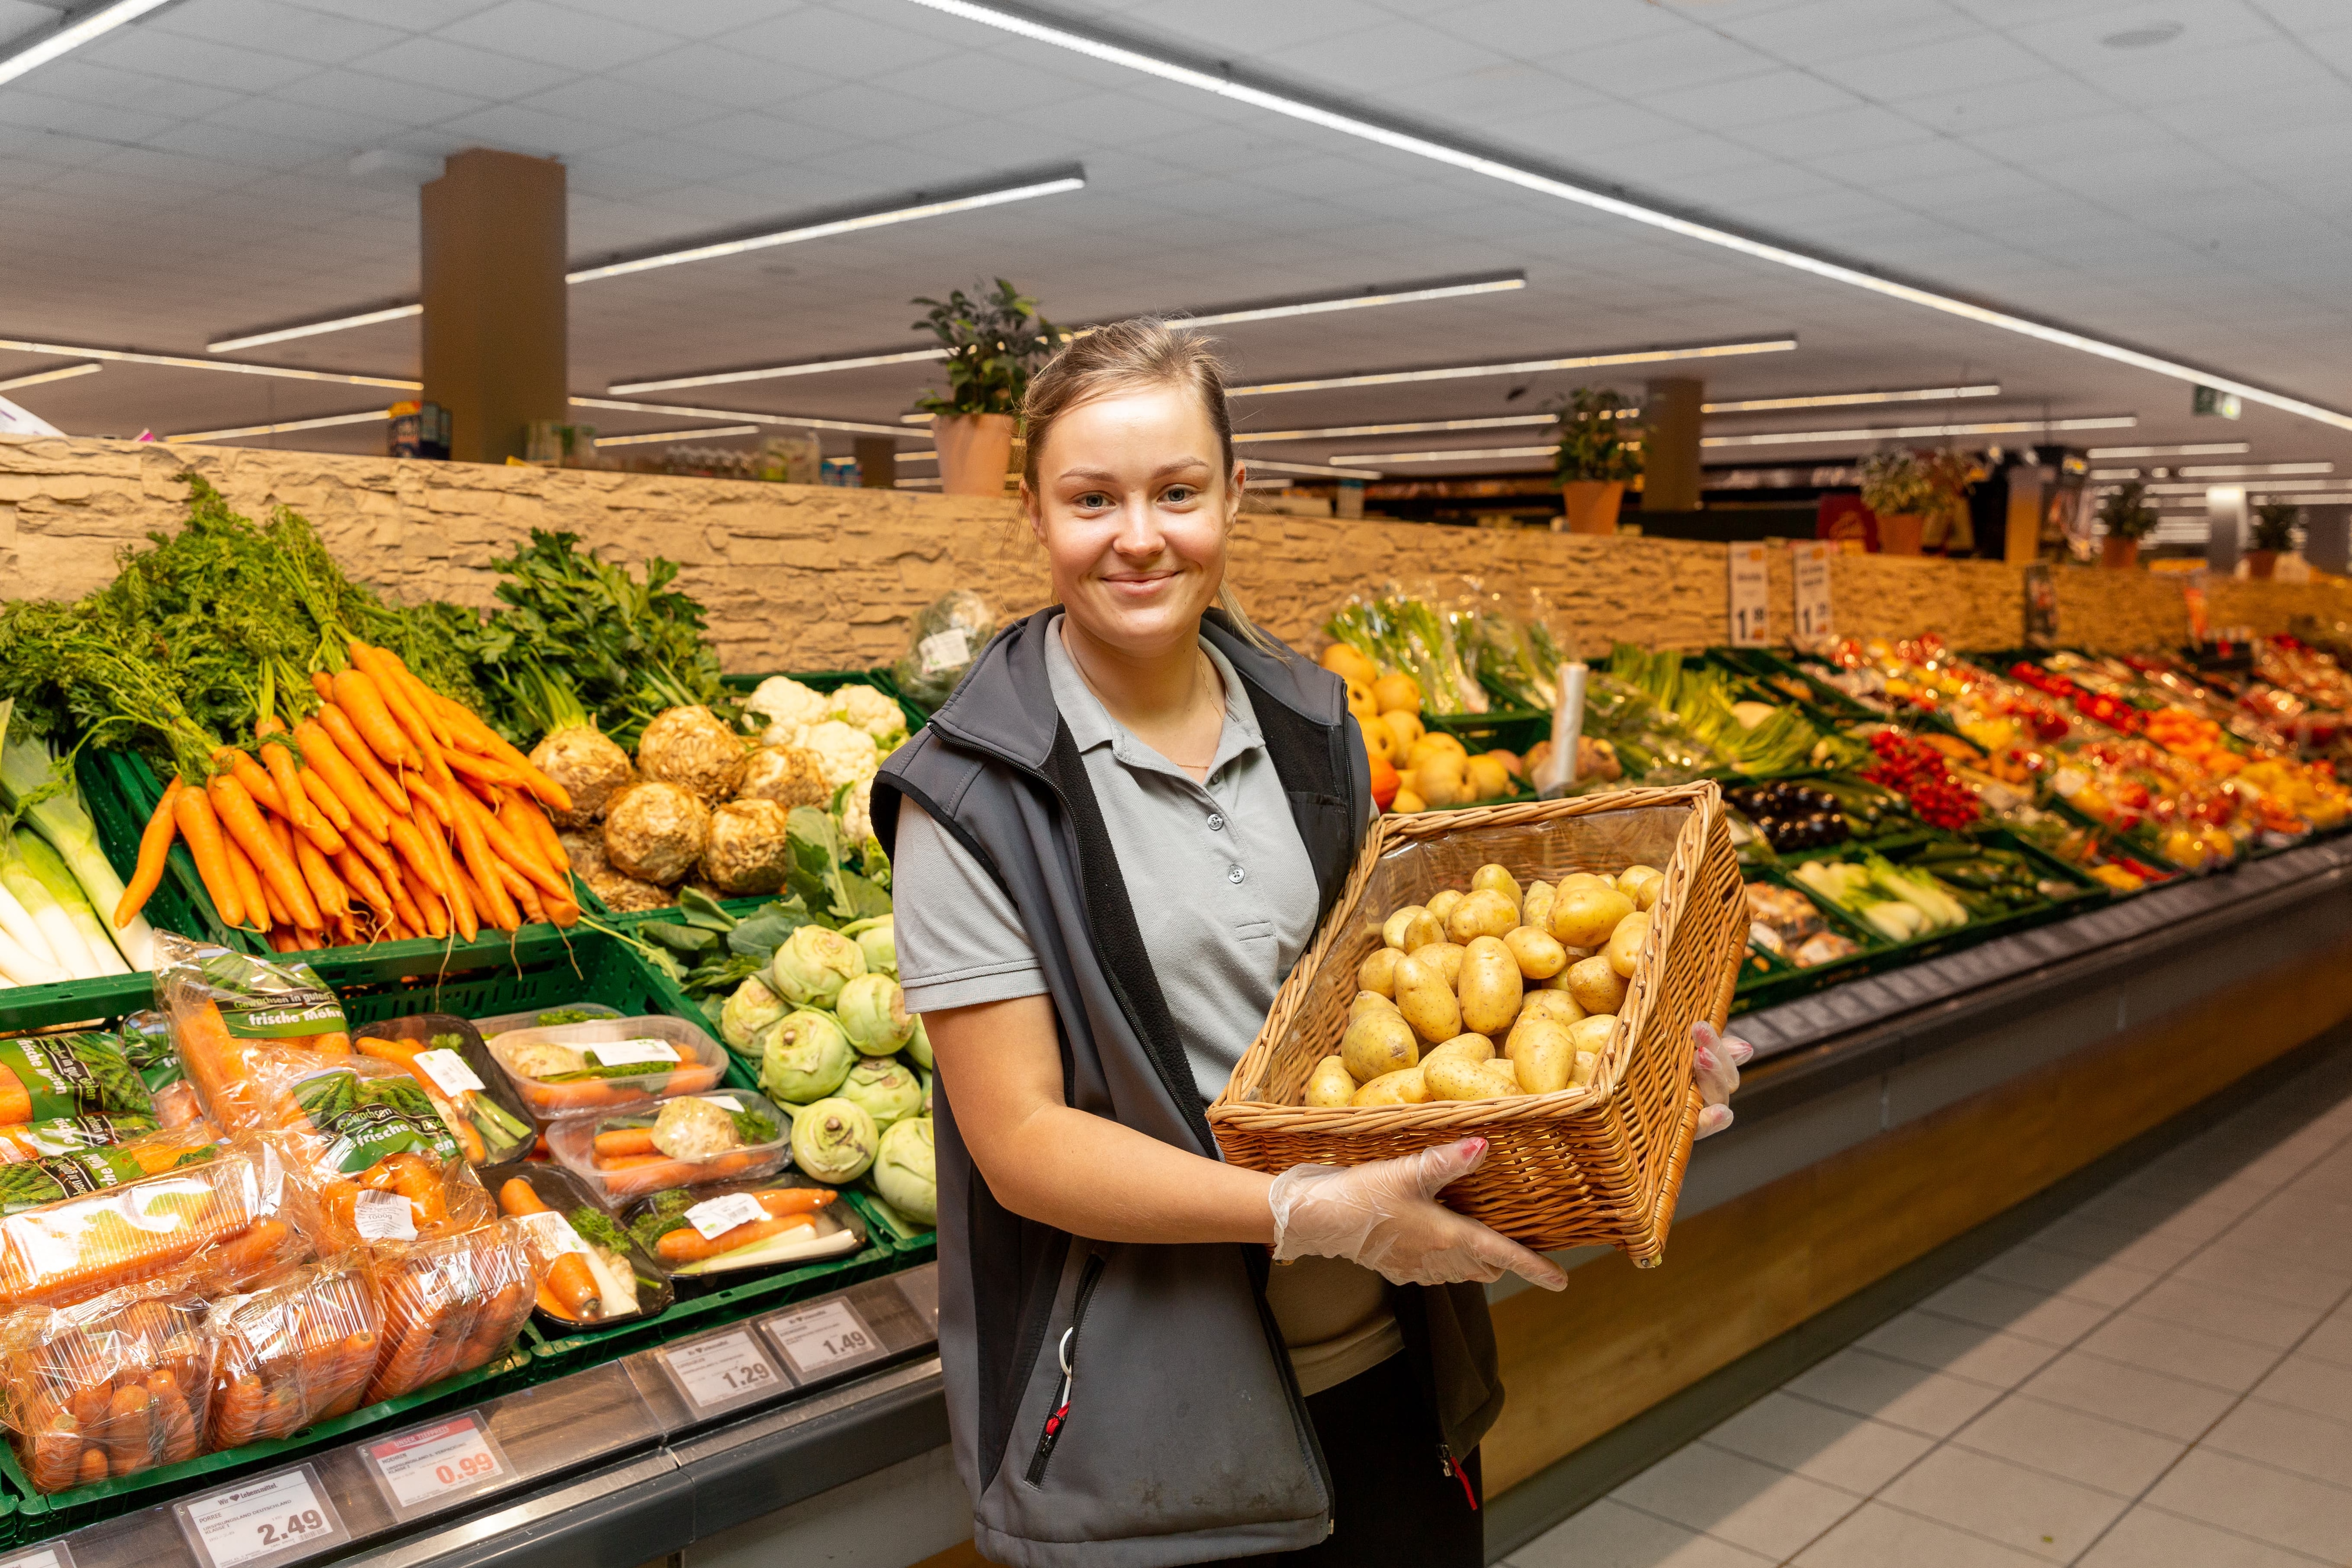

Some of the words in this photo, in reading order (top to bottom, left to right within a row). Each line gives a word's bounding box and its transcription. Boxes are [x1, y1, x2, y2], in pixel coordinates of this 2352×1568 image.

[233, 996, 289, 1009] Gewachsen
[289, 994, 302, 1003] in
[248, 1011, 300, 1026] frische
[302, 1007, 347, 1022] Möhr
[16, 1039, 44, 1067] frische
[336, 1107, 393, 1131] Gewachsen
[356, 1123, 410, 1148] frische
[823, 1330, 866, 1355] 1.49
[723, 1362, 770, 1388] 1.29
[394, 1435, 416, 1447] UNSER
[417, 1425, 450, 1441] TIEFPREIS
[381, 1452, 408, 1465] MOEHREN
[436, 1452, 494, 1484] 0.99
[217, 1497, 229, 1506] Wir
[199, 1512, 222, 1524] PORREE
[202, 1512, 252, 1531] URSPRUNGSLAND
[252, 1499, 292, 1515] DEUTSCHLAND
[204, 1525, 226, 1535] KLASSE
[257, 1509, 323, 1546] 2.49
